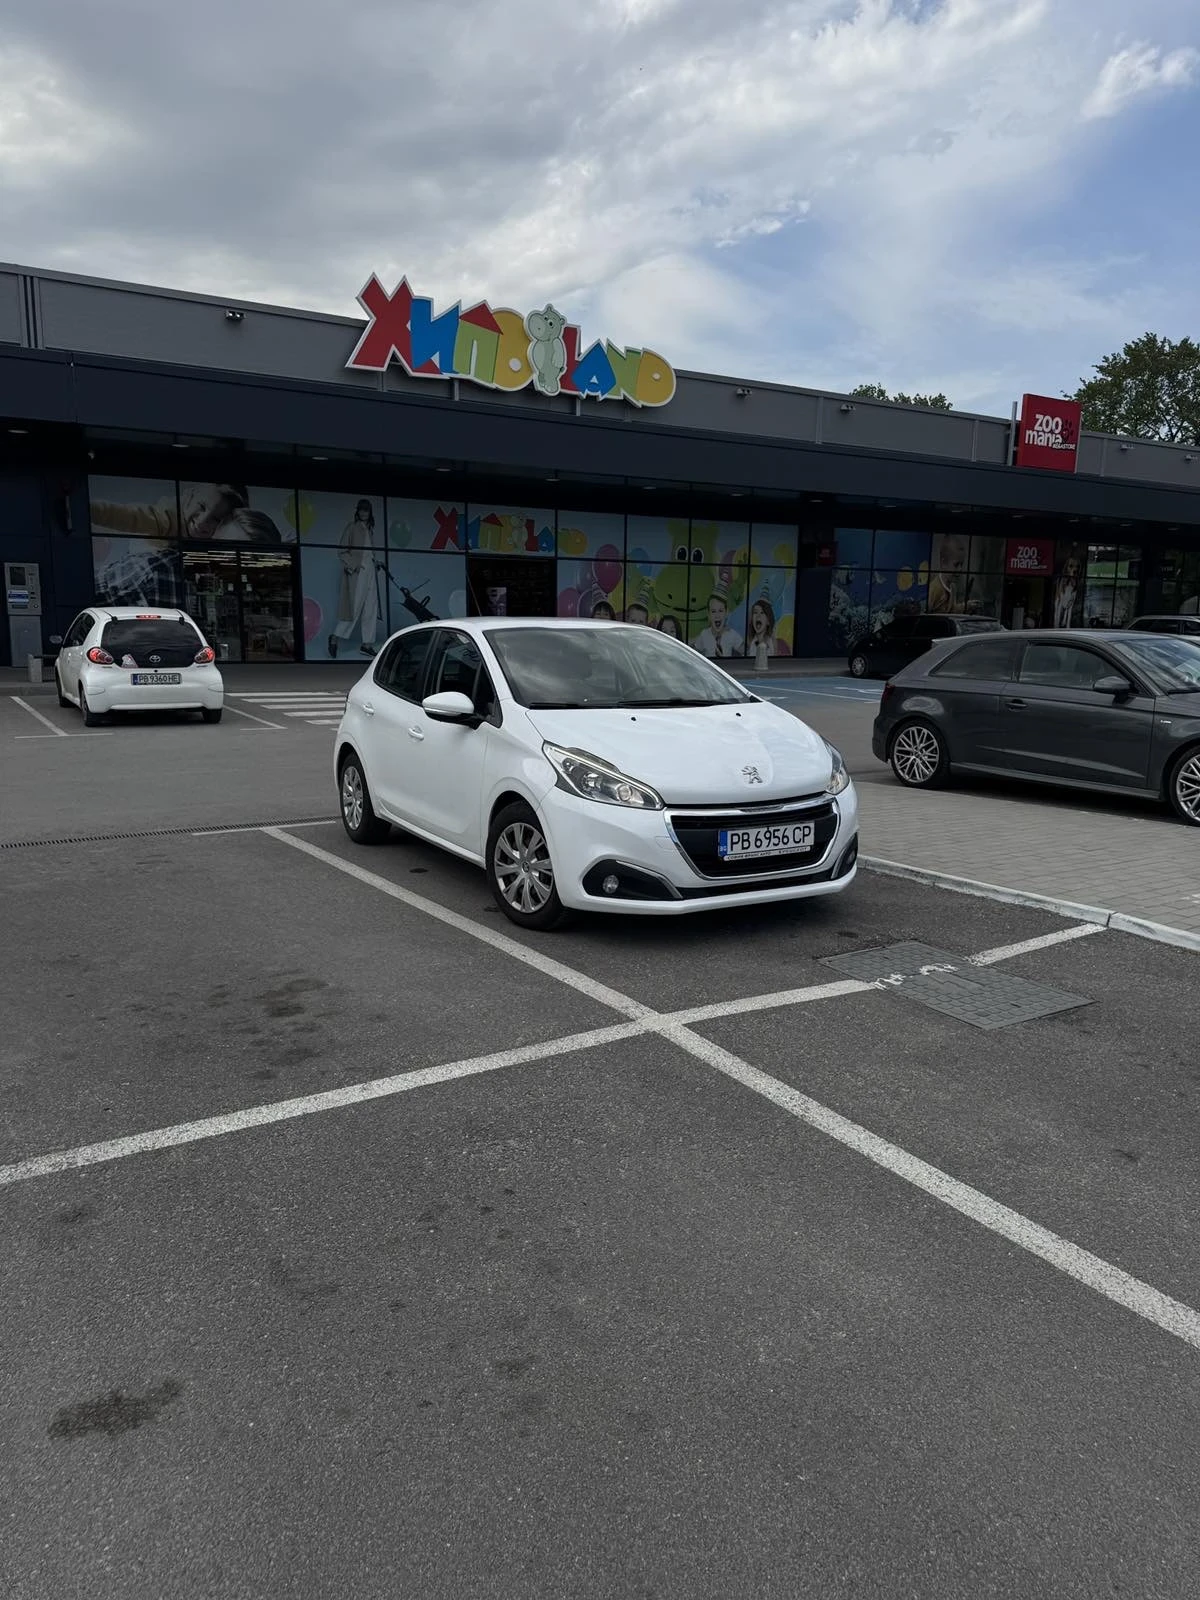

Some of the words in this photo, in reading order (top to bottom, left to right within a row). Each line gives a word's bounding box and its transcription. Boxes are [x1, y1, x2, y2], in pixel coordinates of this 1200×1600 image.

[1025, 429, 1063, 447] mania
[149, 675, 168, 683] 9360
[730, 832, 751, 852] PB
[754, 827, 790, 849] 6956
[792, 825, 812, 844] CP
